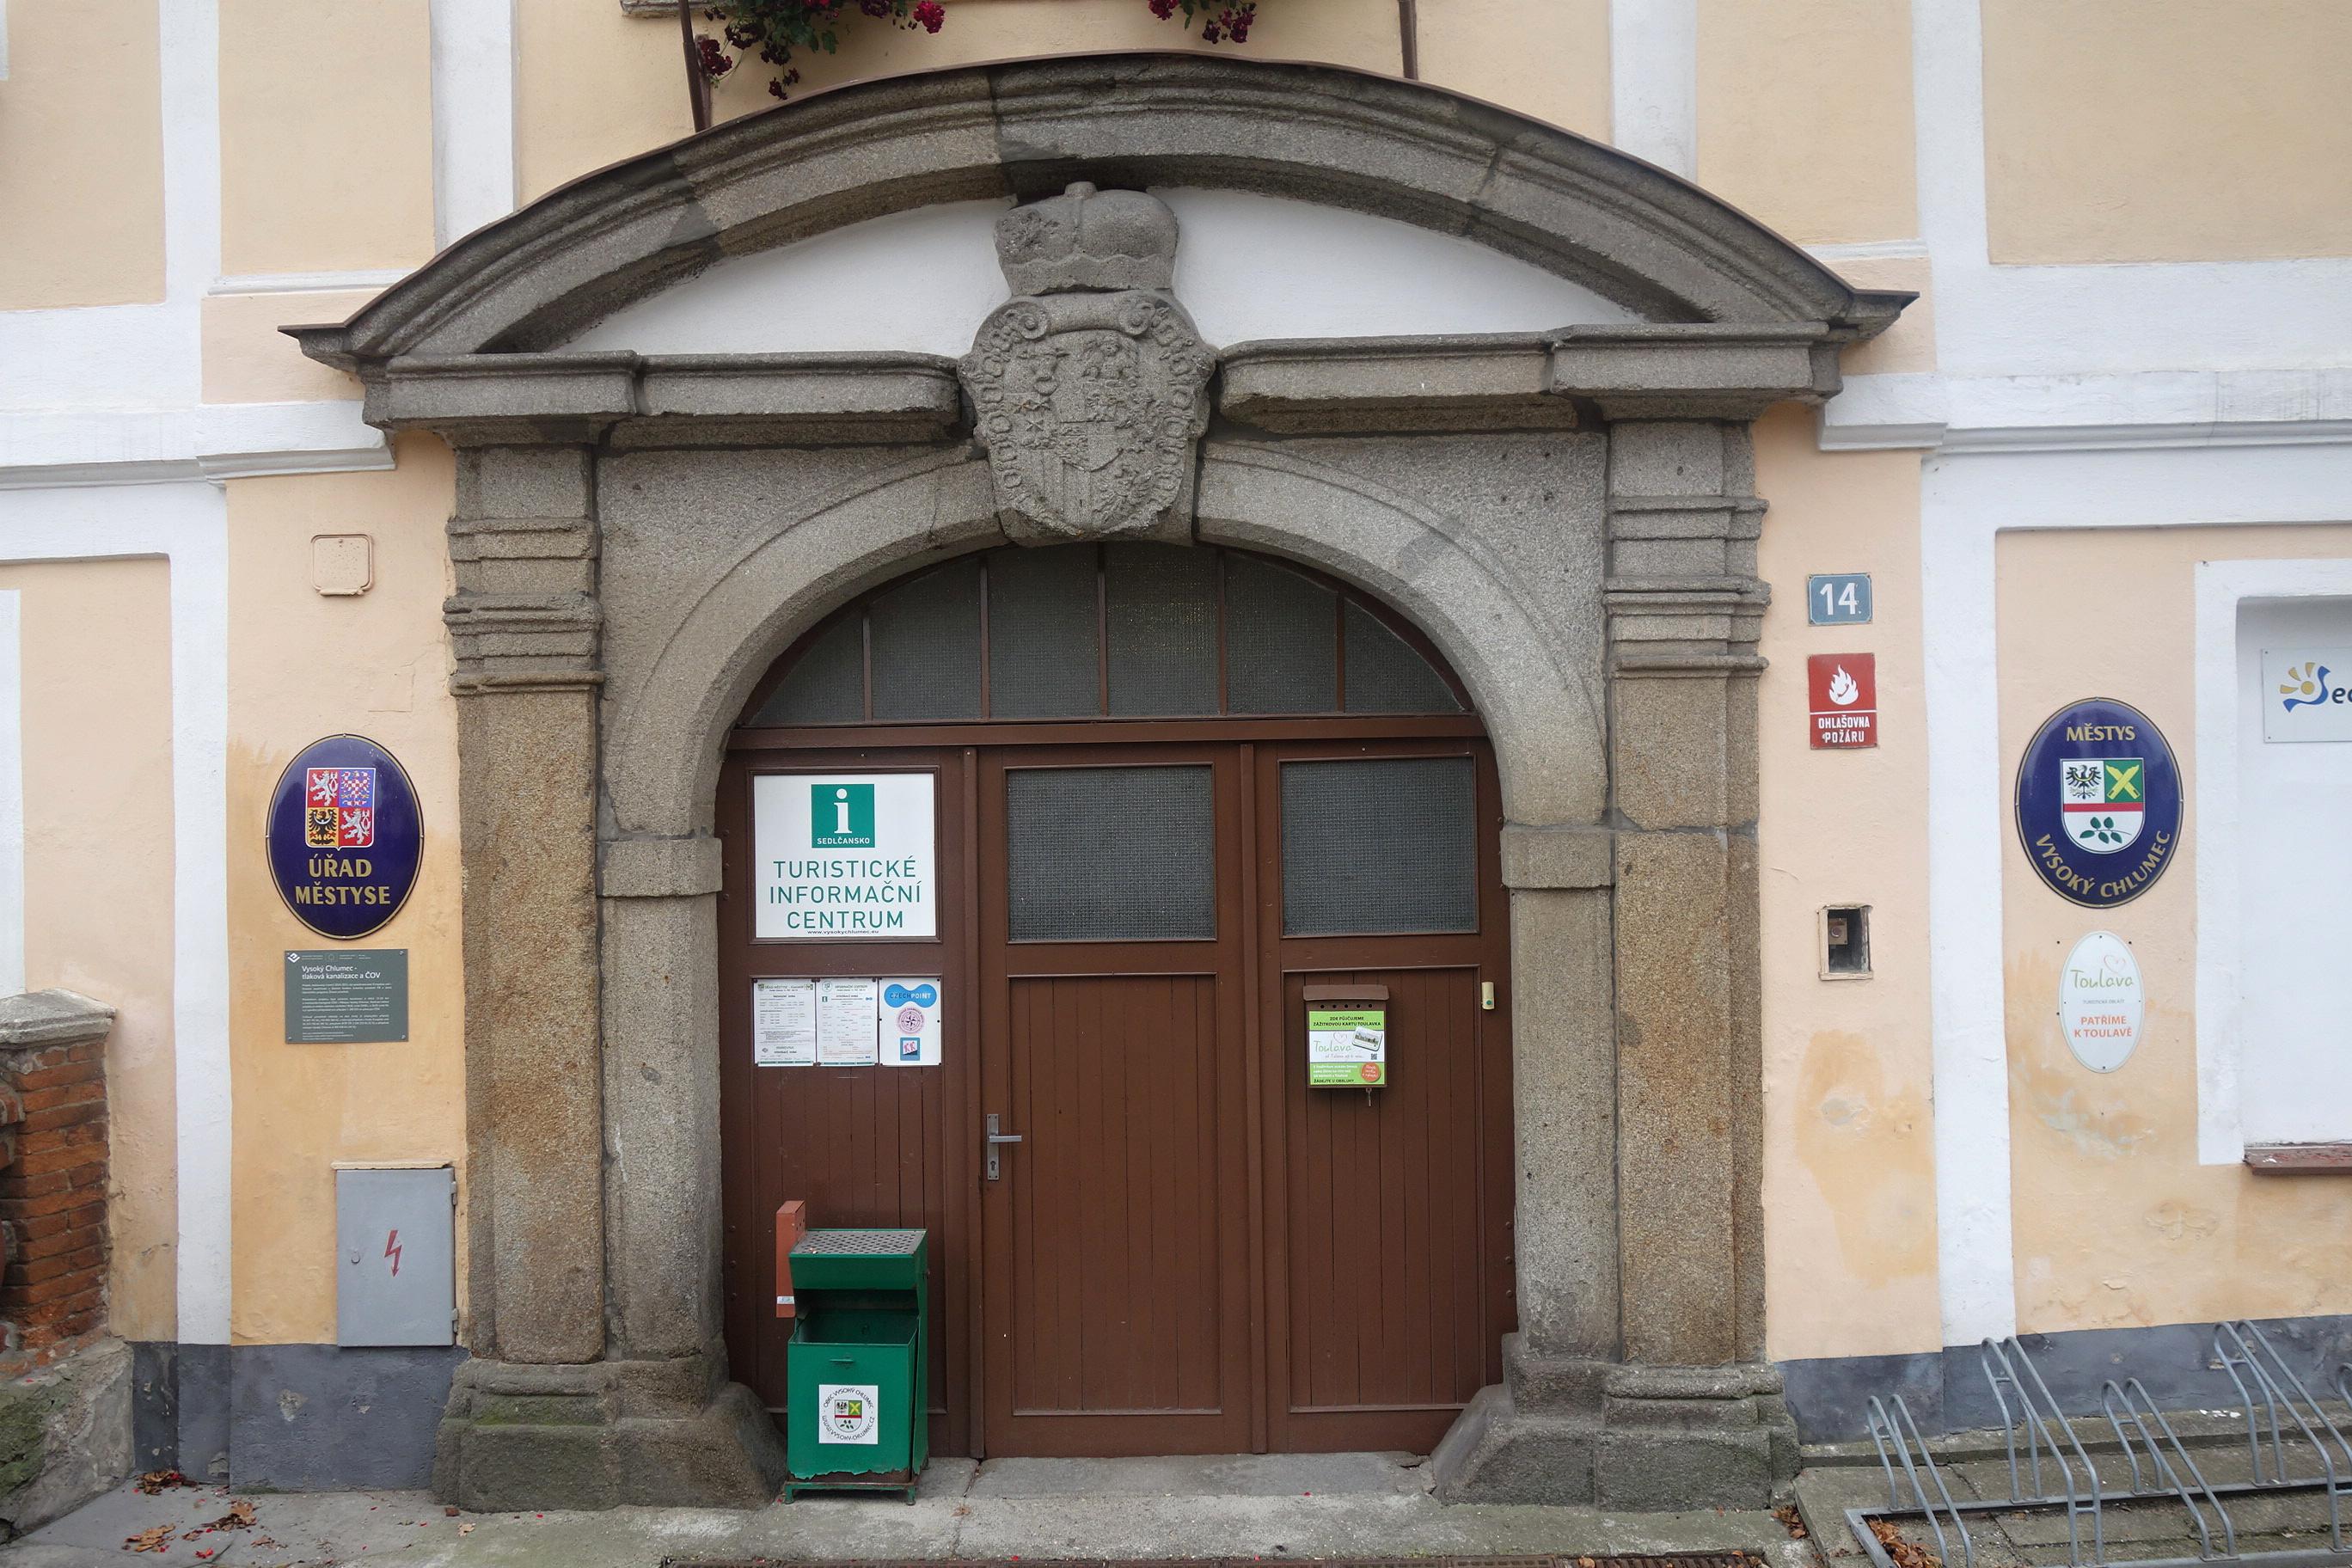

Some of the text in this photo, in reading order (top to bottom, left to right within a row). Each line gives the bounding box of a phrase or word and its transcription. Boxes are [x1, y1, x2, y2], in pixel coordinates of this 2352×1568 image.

[1818, 714, 1870, 729] OHLAŠOVNA
[1823, 730, 1865, 744] POŽÁRU
[2067, 722, 2136, 742] MĚSTYS
[817, 836, 870, 845] SEDLČANSKO
[309, 853, 372, 878] ÚŘAD
[773, 854, 916, 879] TURISTICKÉ
[2036, 830, 2171, 897] VYSOKÝ CHLUMEC
[295, 882, 390, 905] MĚSTYSE
[769, 880, 922, 903] INFORMAČNÍ
[787, 910, 903, 929] CENTRUM
[364, 971, 381, 979] ČOV
[2070, 969, 2135, 989] Toulava
[2080, 1015, 2127, 1026] PATŘÍME
[2073, 1029, 2081, 1038] K
